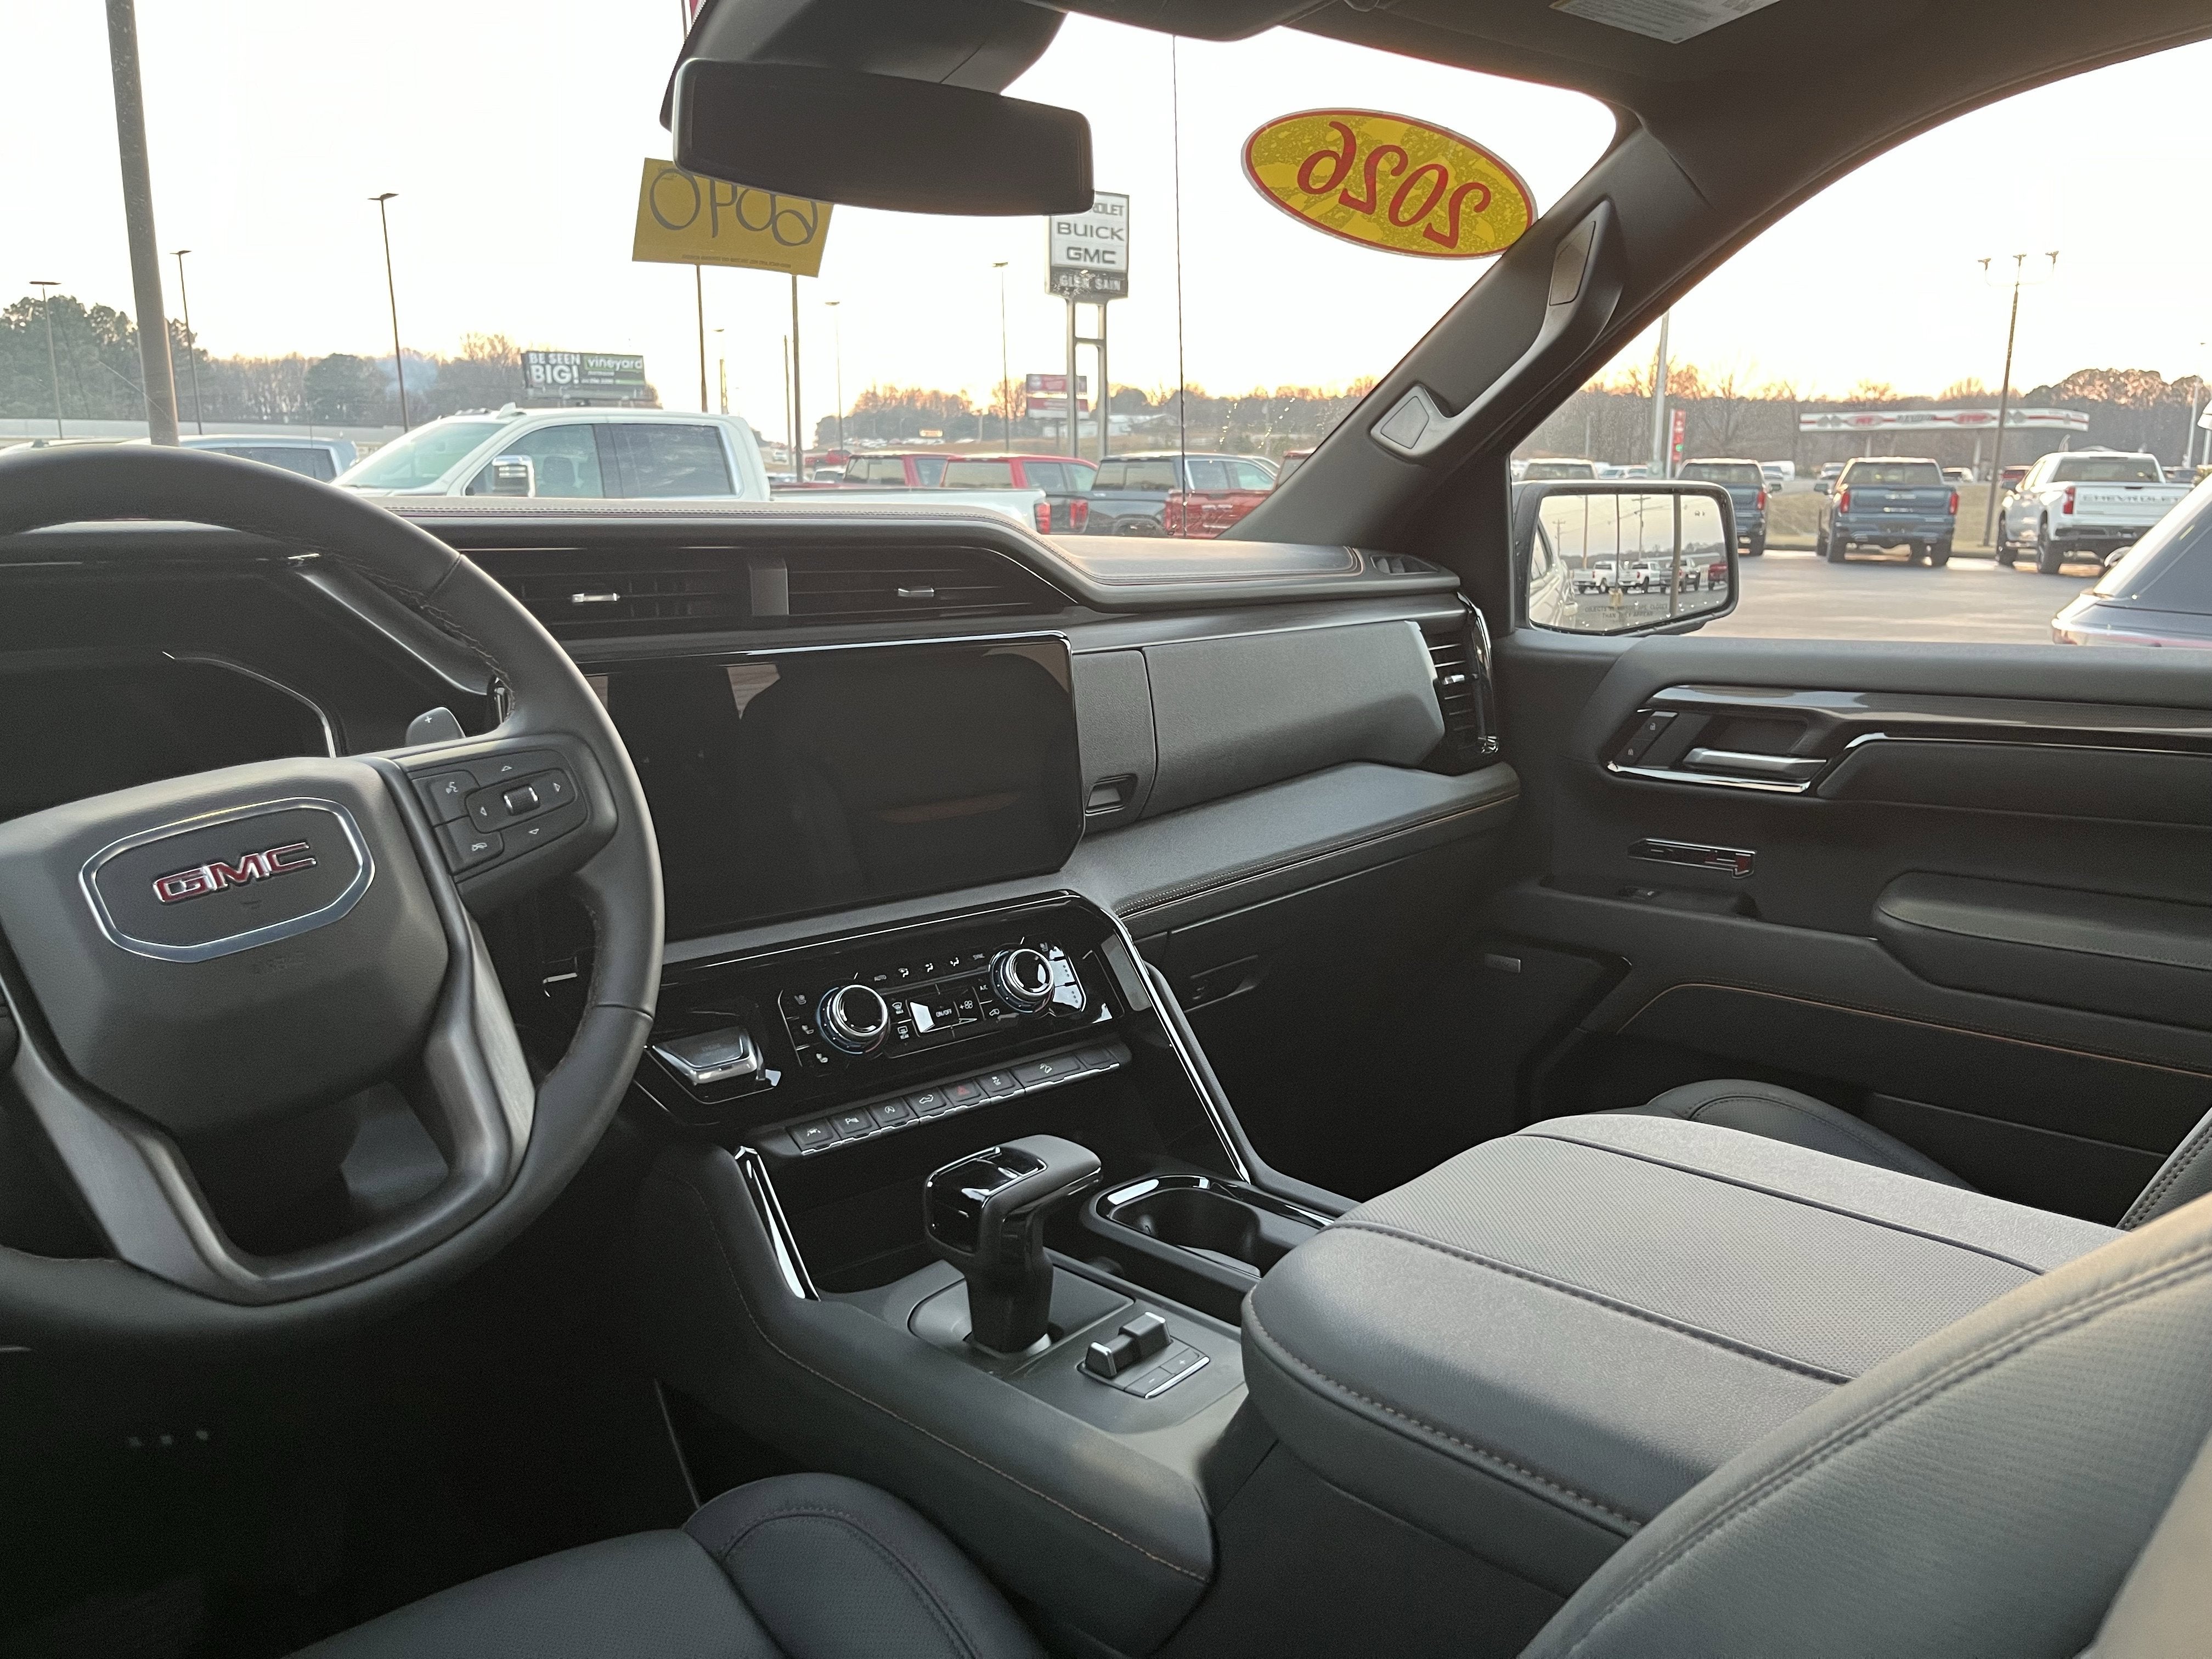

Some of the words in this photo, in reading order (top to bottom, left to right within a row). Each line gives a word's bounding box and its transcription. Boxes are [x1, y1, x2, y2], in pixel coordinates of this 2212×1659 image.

[1057, 222, 1125, 241] BUICK
[1066, 246, 1116, 264] GMC
[528, 352, 546, 364] BE
[548, 353, 580, 365] SEEN
[588, 357, 642, 371] vineyard
[529, 364, 579, 385] BIG!
[153, 842, 317, 903] GMC
[935, 1008, 952, 1018] ON/OFF
